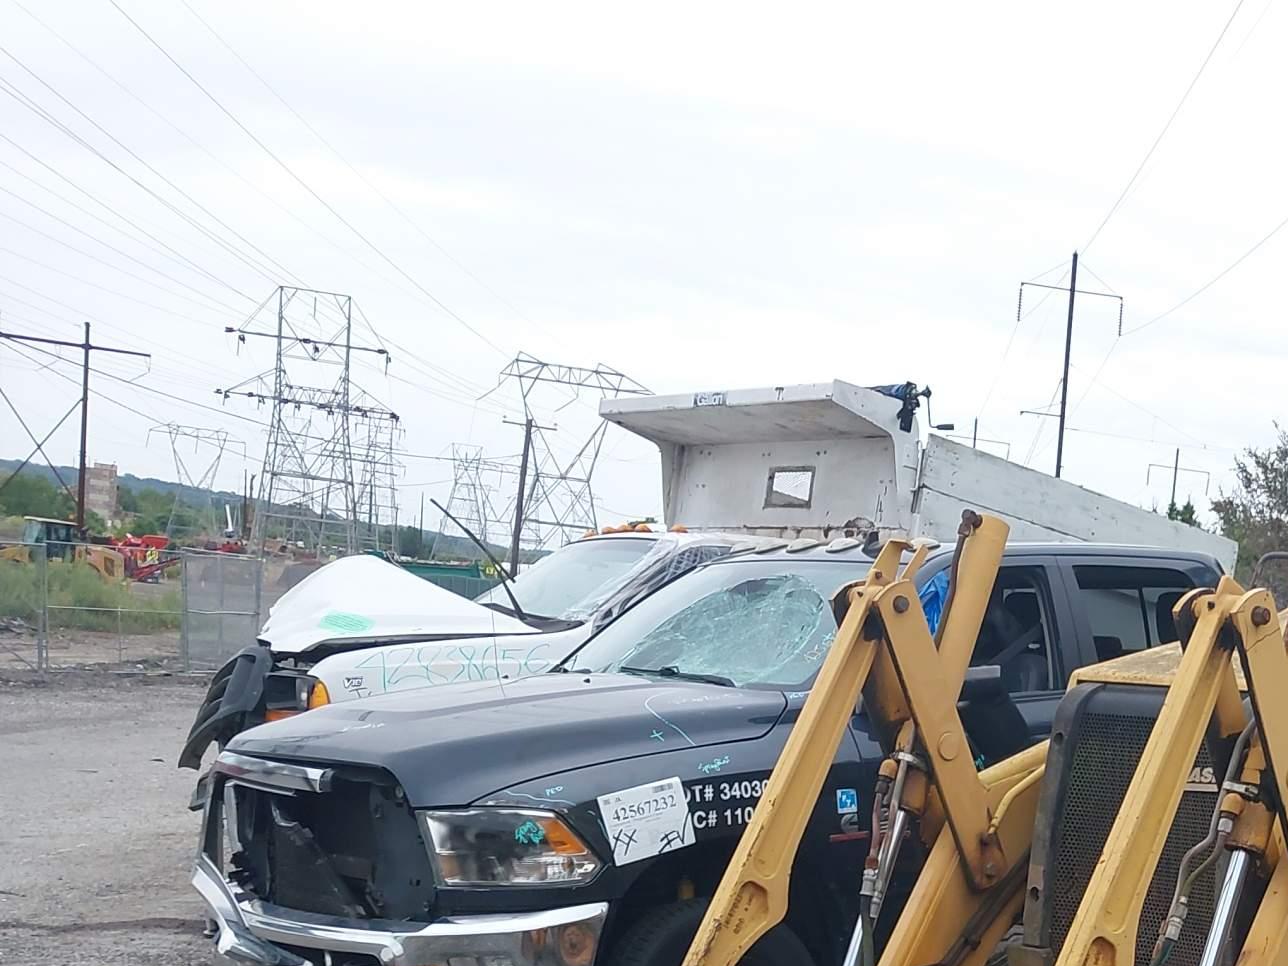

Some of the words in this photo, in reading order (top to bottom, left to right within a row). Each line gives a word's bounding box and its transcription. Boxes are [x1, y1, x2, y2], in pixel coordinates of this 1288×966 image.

[1186, 767, 1217, 783] AS
[612, 794, 677, 822] 42567232
[693, 810, 718, 828] C#
